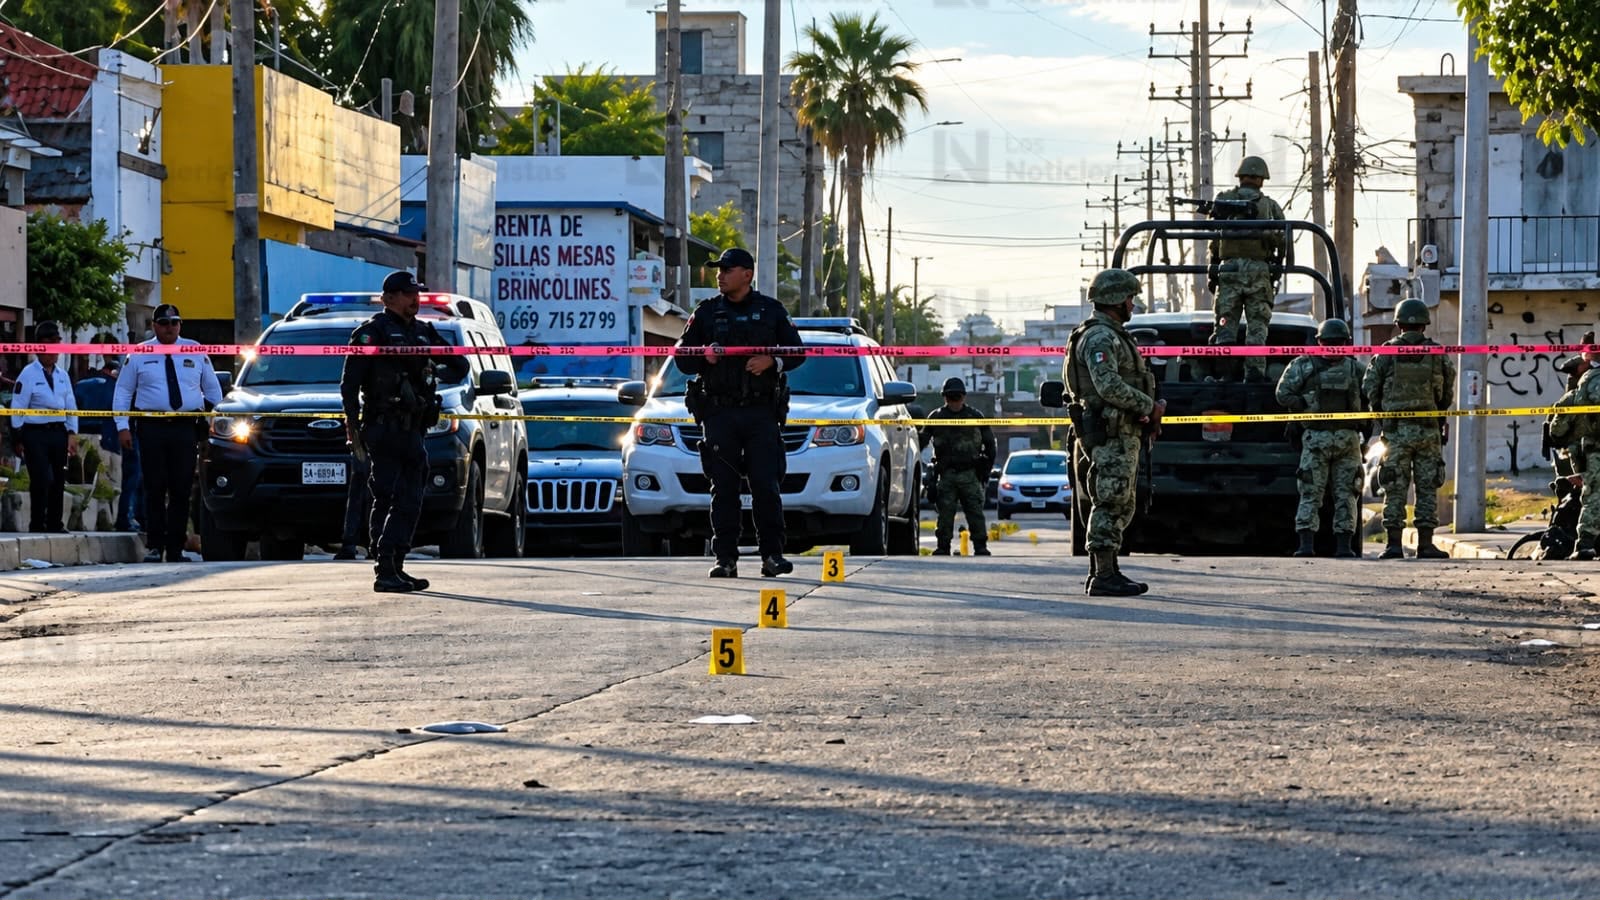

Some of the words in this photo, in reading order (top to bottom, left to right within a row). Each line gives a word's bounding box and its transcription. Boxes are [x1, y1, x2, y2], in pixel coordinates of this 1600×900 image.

[495, 214, 552, 237] RENTA
[560, 215, 583, 237] DE
[494, 243, 550, 267] SILLAS
[557, 245, 615, 267] MESAS
[510, 311, 539, 330] 669
[549, 311, 575, 329] 715
[828, 558, 839, 577] 3
[765, 596, 780, 621] 4
[718, 638, 735, 668] 5
